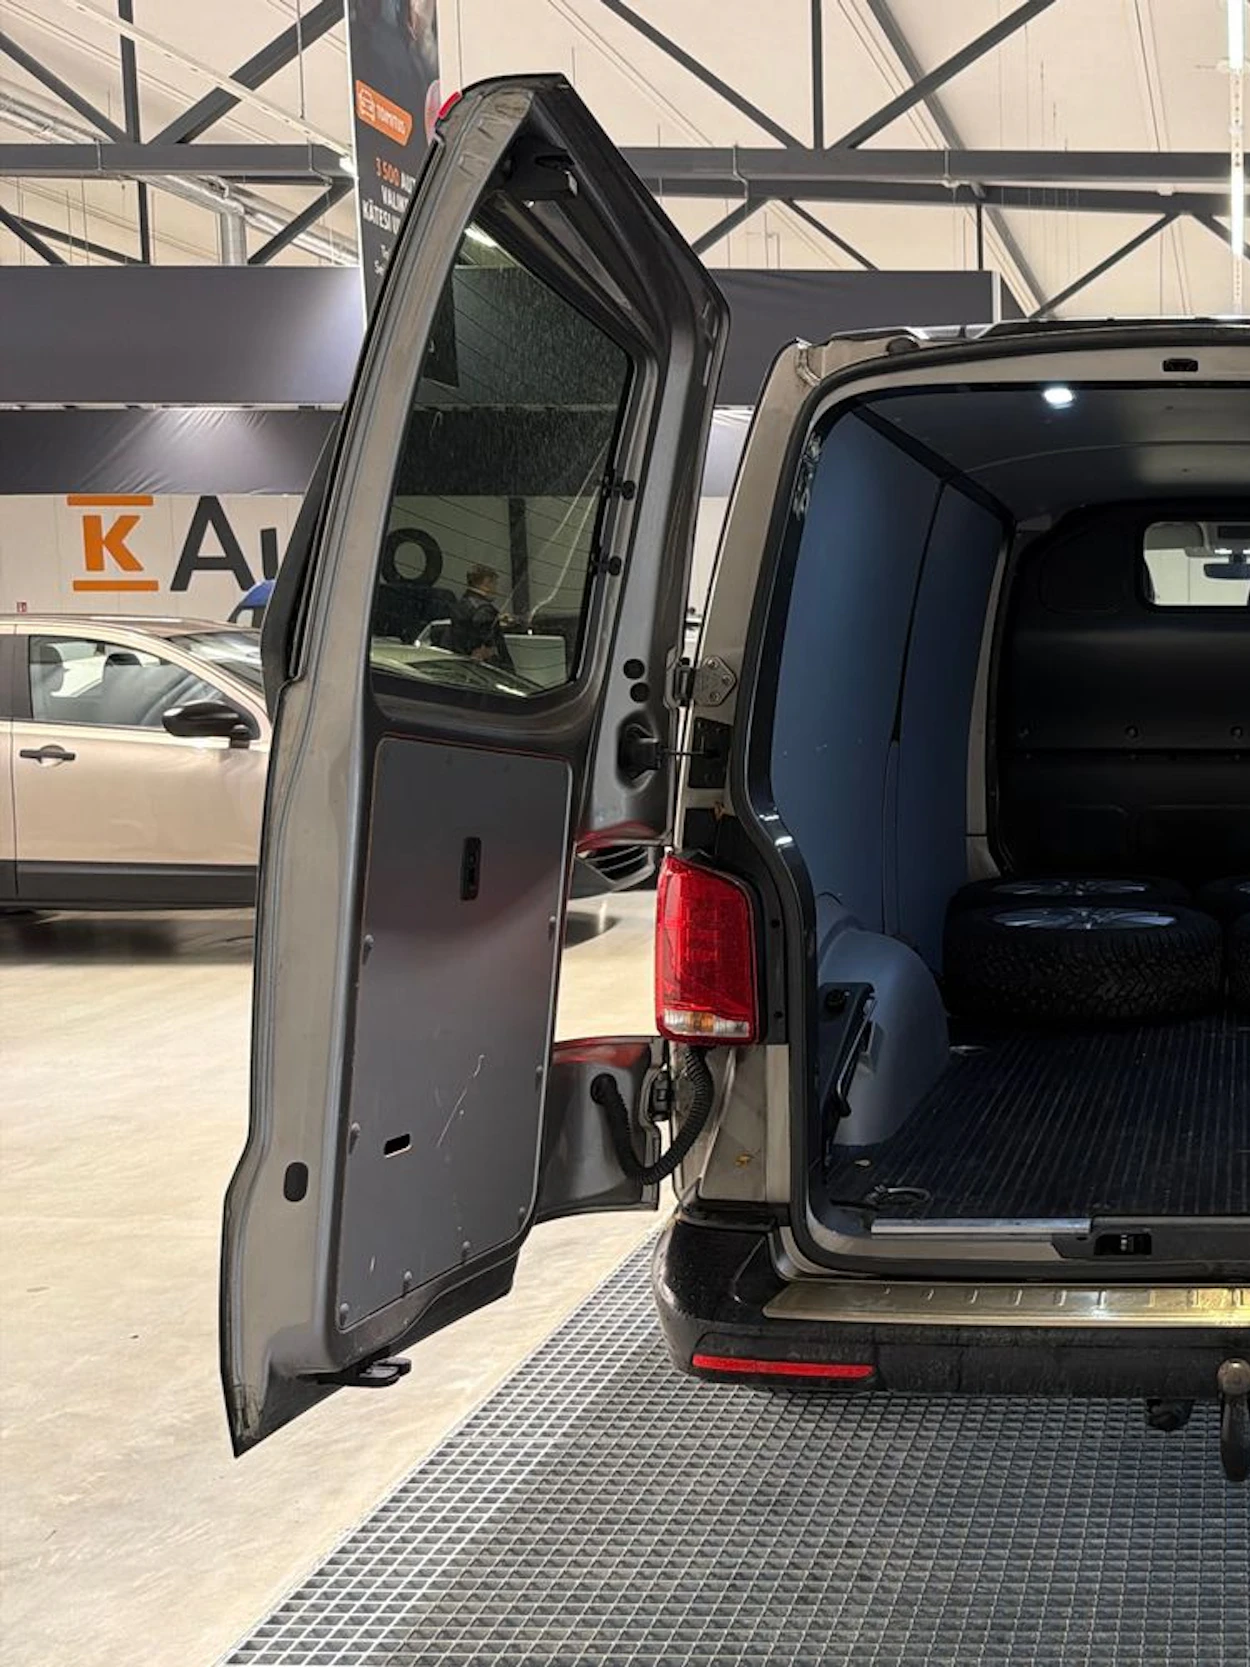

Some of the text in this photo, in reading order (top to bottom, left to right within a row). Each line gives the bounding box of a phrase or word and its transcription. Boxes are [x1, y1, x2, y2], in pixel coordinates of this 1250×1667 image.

[375, 157, 416, 193] 3 500 AUT
[362, 198, 392, 232] KÄTESI
